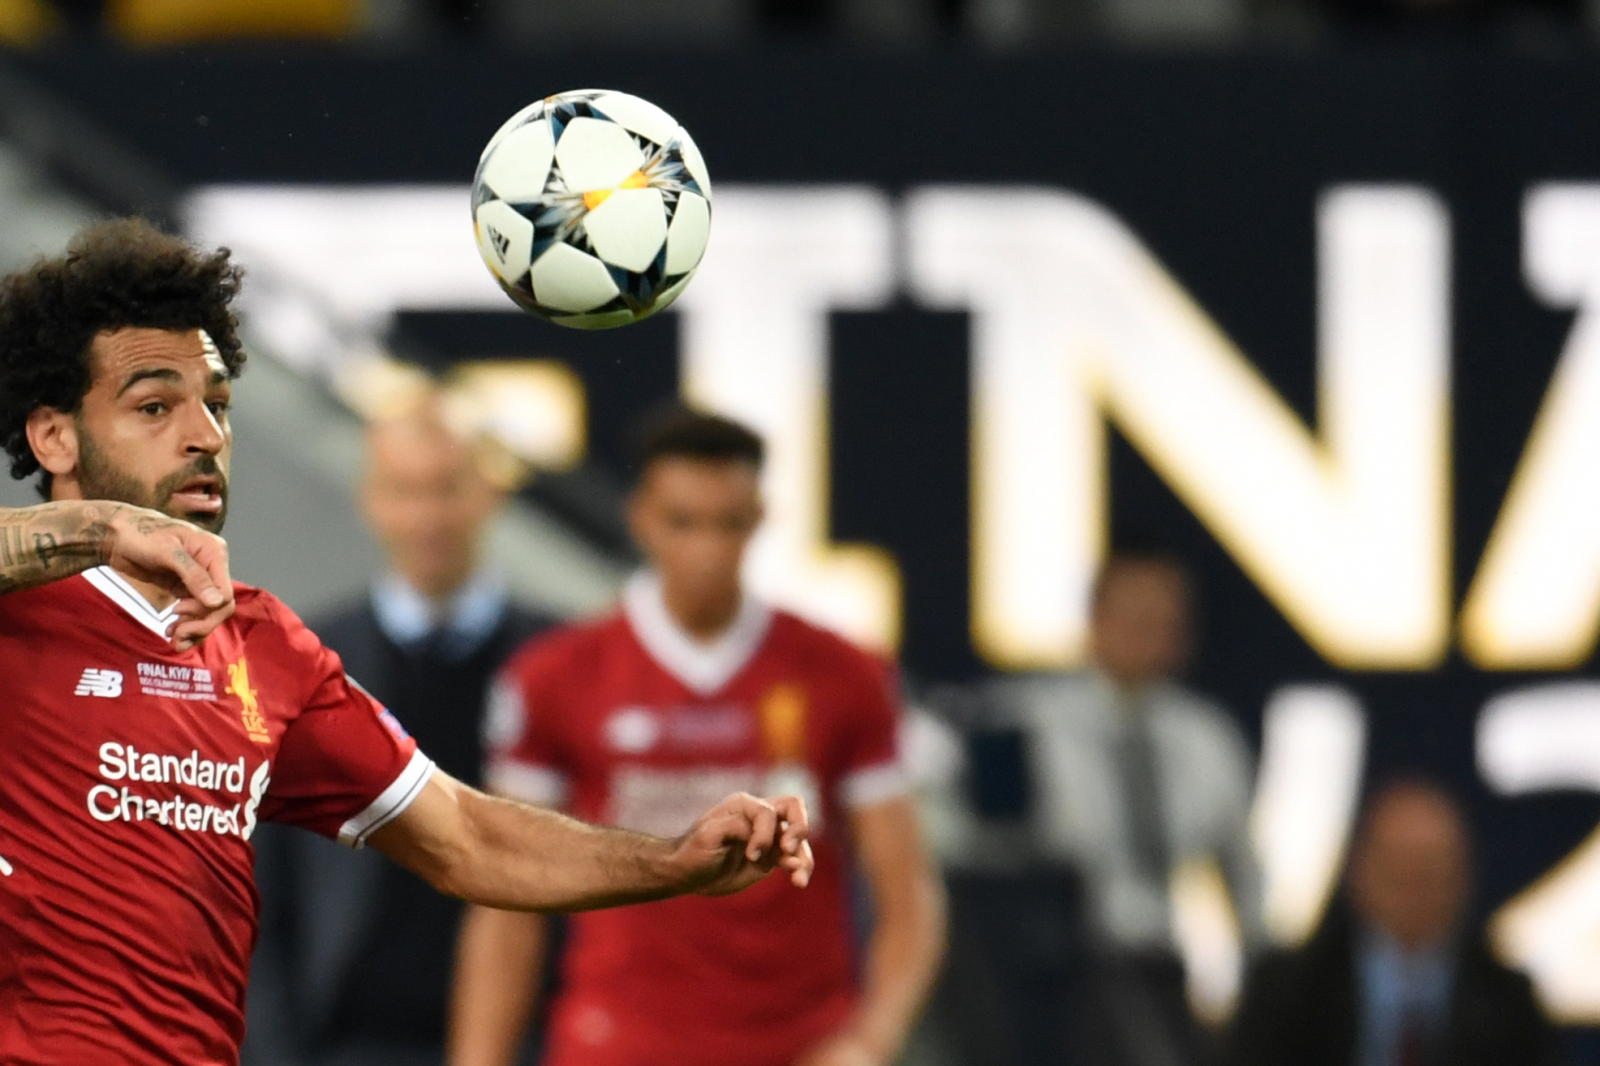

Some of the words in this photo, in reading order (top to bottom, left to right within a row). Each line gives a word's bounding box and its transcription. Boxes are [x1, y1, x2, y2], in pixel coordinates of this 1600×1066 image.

[137, 662, 167, 679] FINAL
[168, 665, 191, 681] KYIV
[99, 741, 245, 793] Standard
[87, 784, 241, 836] Chartered
